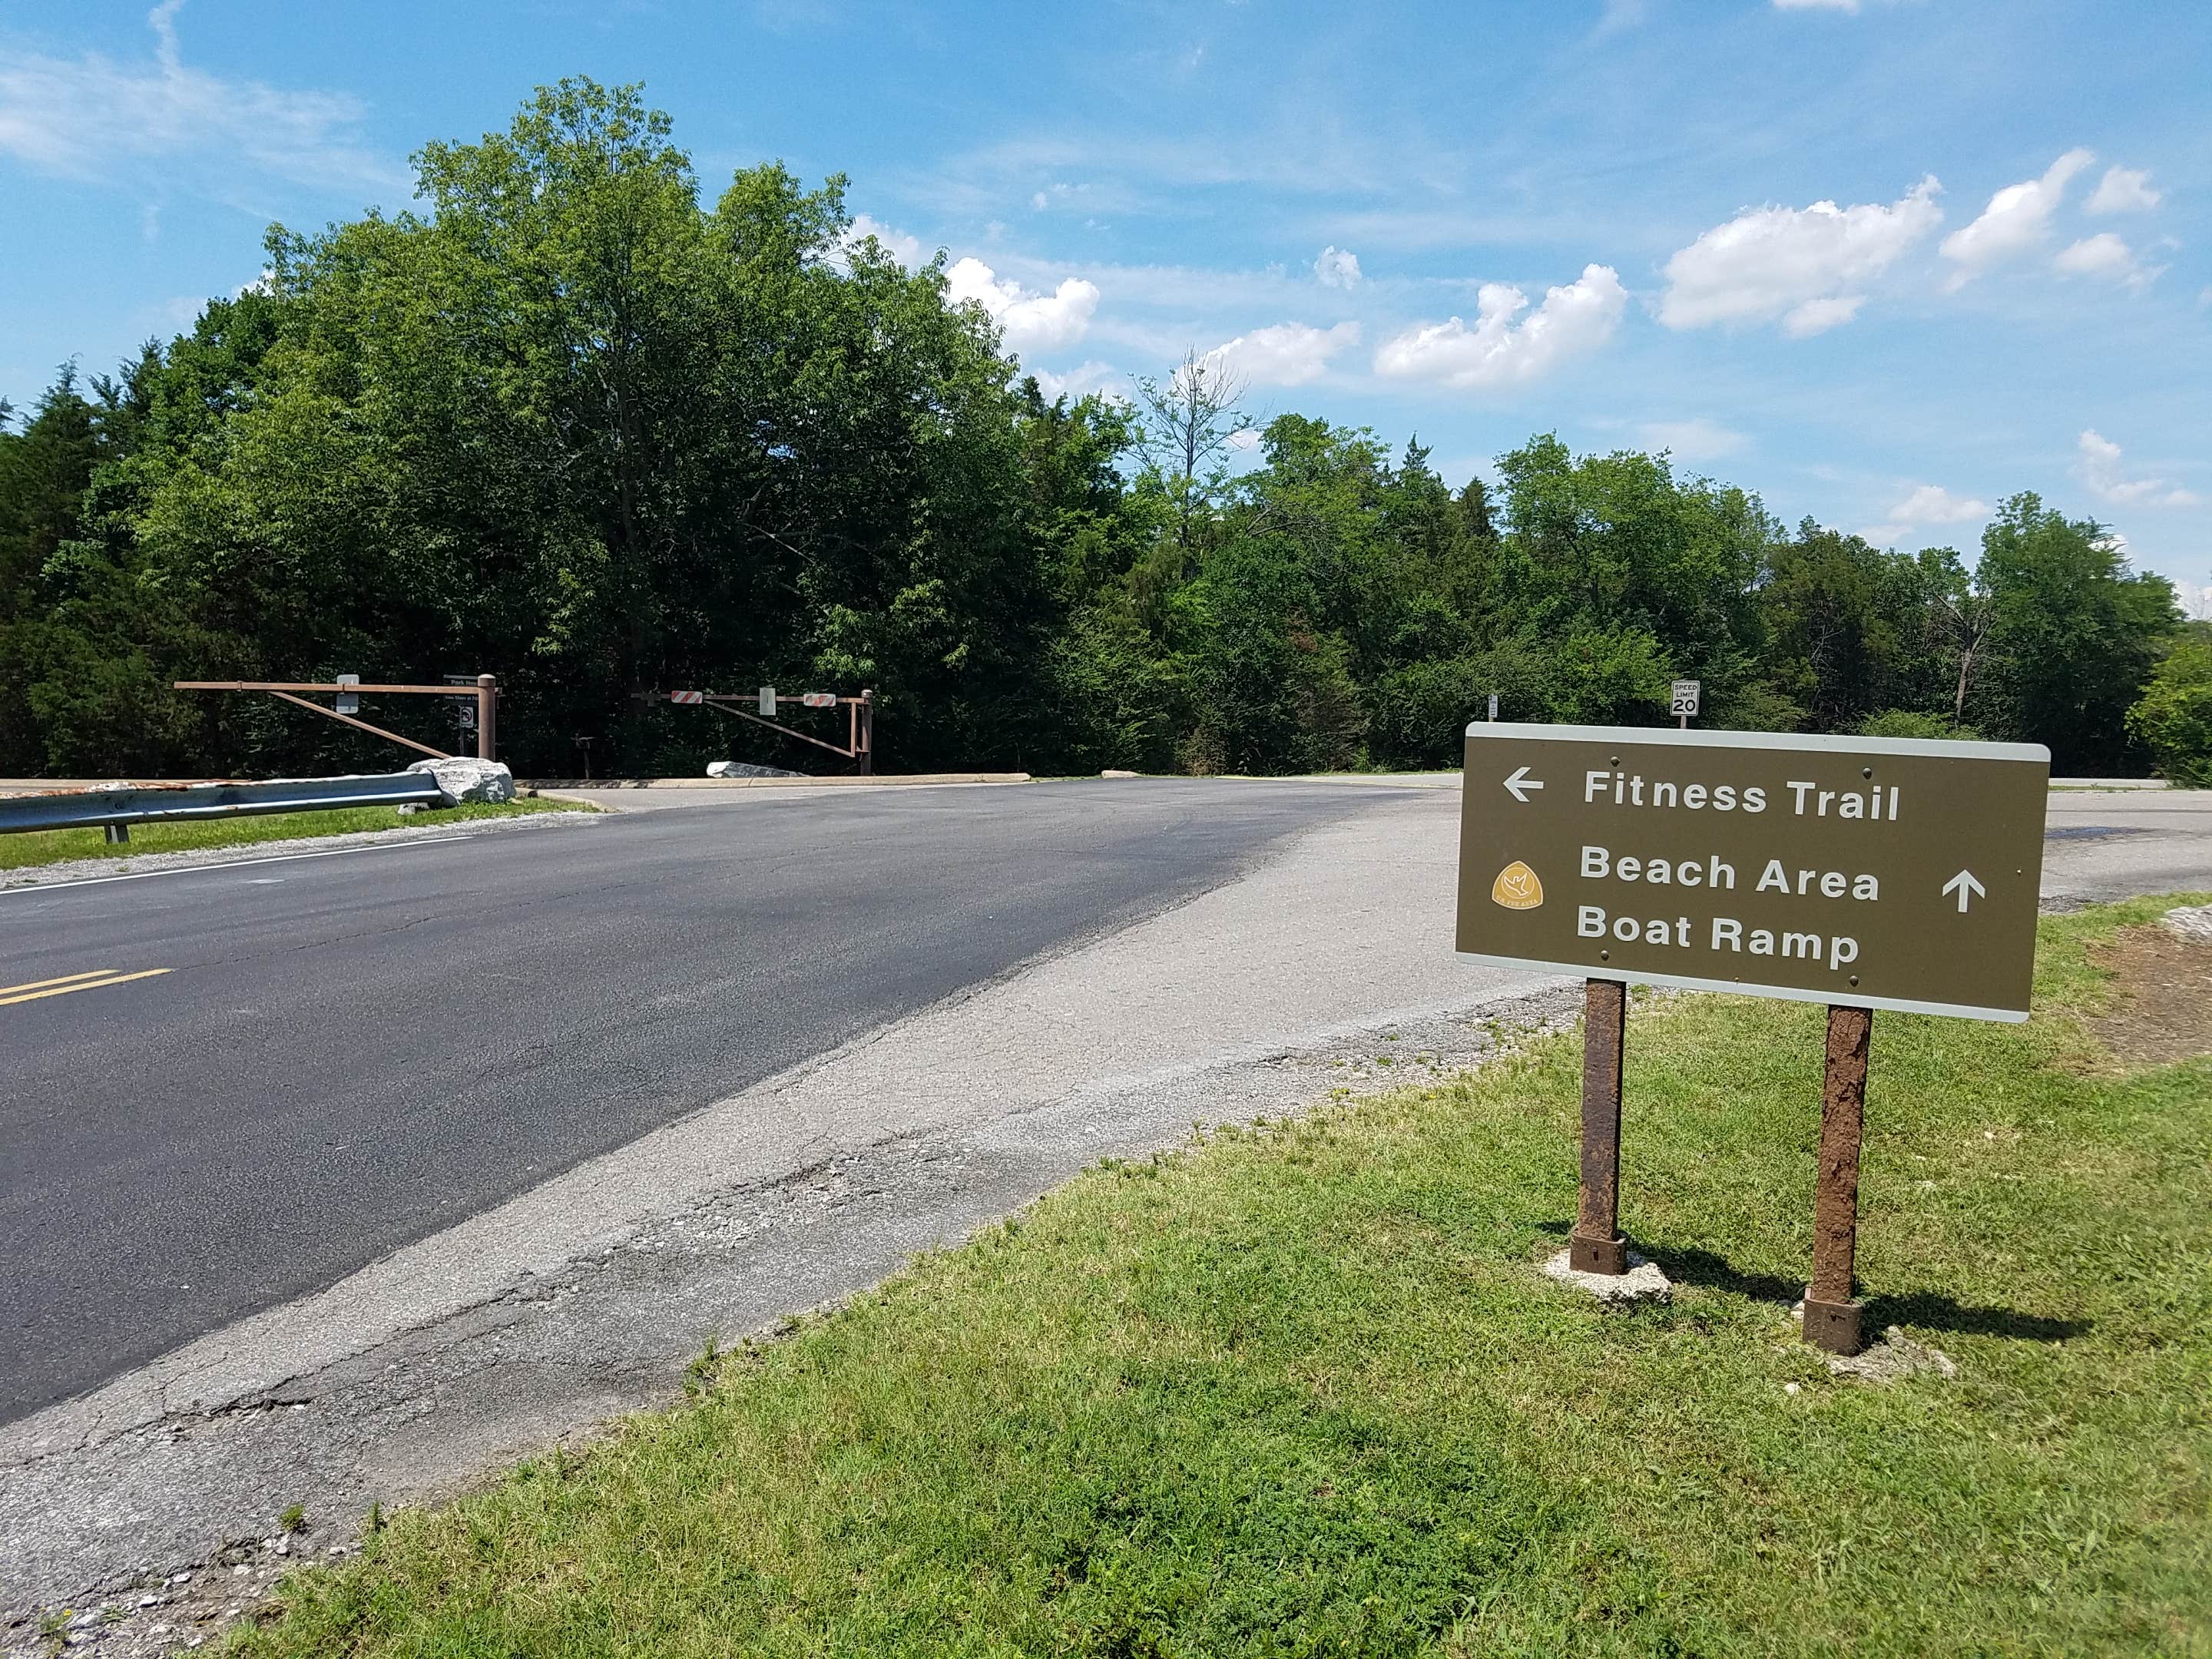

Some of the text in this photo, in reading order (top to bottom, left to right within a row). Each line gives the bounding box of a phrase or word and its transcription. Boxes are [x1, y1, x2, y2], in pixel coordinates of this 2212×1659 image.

[1673, 699, 1696, 712] 20
[1584, 770, 1899, 821] Fitness Trail
[1581, 846, 1879, 901] Beach Area
[1577, 905, 1859, 971] Boat Ramp
